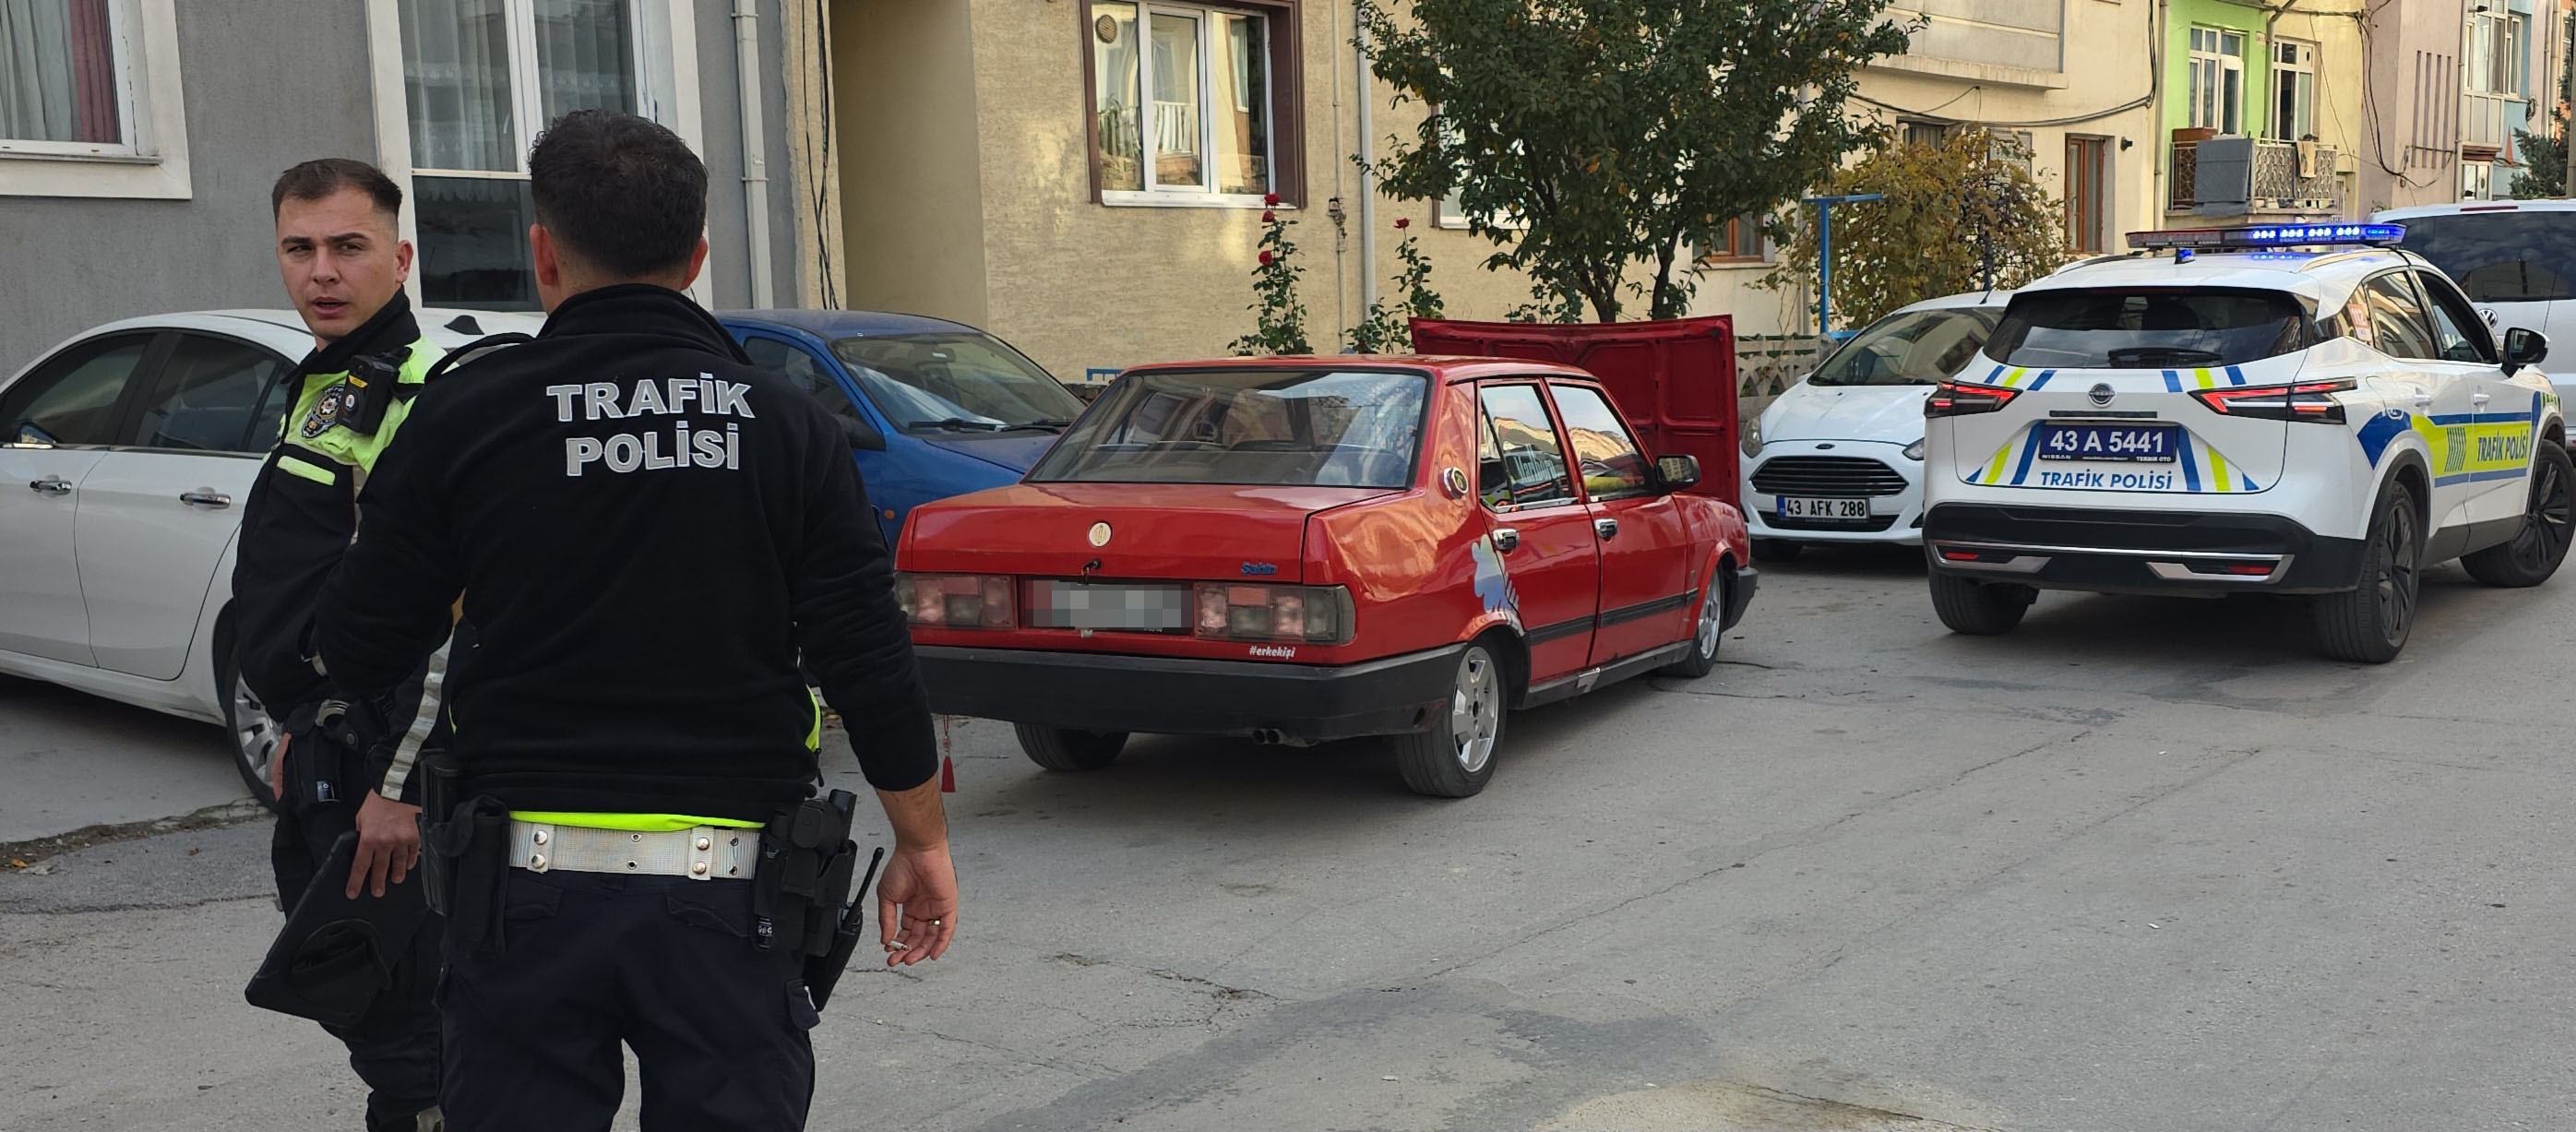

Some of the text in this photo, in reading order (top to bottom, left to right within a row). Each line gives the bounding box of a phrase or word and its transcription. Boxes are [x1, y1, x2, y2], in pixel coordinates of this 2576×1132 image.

[546, 372, 756, 422] TRAFİK
[566, 420, 739, 477] POLİSİ
[2050, 430, 2164, 453] 43 A 5441
[2477, 429, 2529, 462] TRAFİK POLİSİ
[2041, 469, 2173, 489] TRAFİK POLİSİ
[1786, 500, 1865, 518] 43 AFK 288
[1249, 645, 1296, 661] #erkekişi
